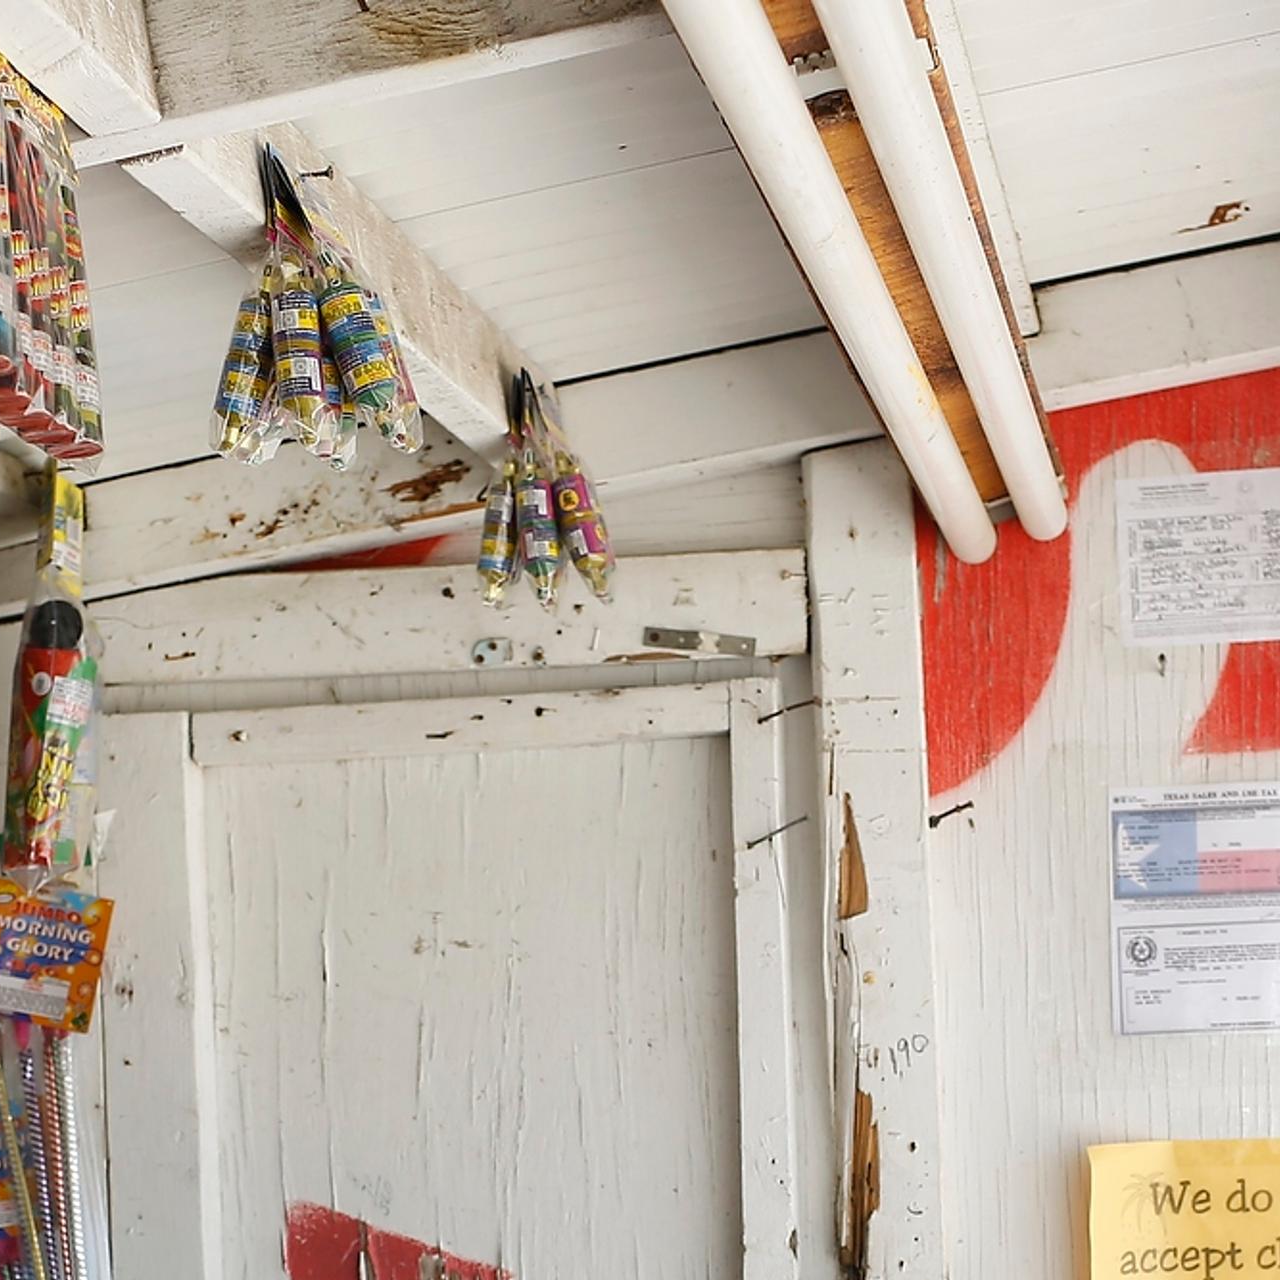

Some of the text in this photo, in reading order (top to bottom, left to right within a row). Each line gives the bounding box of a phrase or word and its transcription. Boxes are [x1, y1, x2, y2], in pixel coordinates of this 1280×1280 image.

[1192, 792, 1217, 800] SALES
[1222, 791, 1239, 799] AND
[1261, 789, 1278, 797] TAX
[6, 937, 75, 962] GLORY
[1150, 1181, 1211, 1216] We
[1225, 1178, 1273, 1213] do
